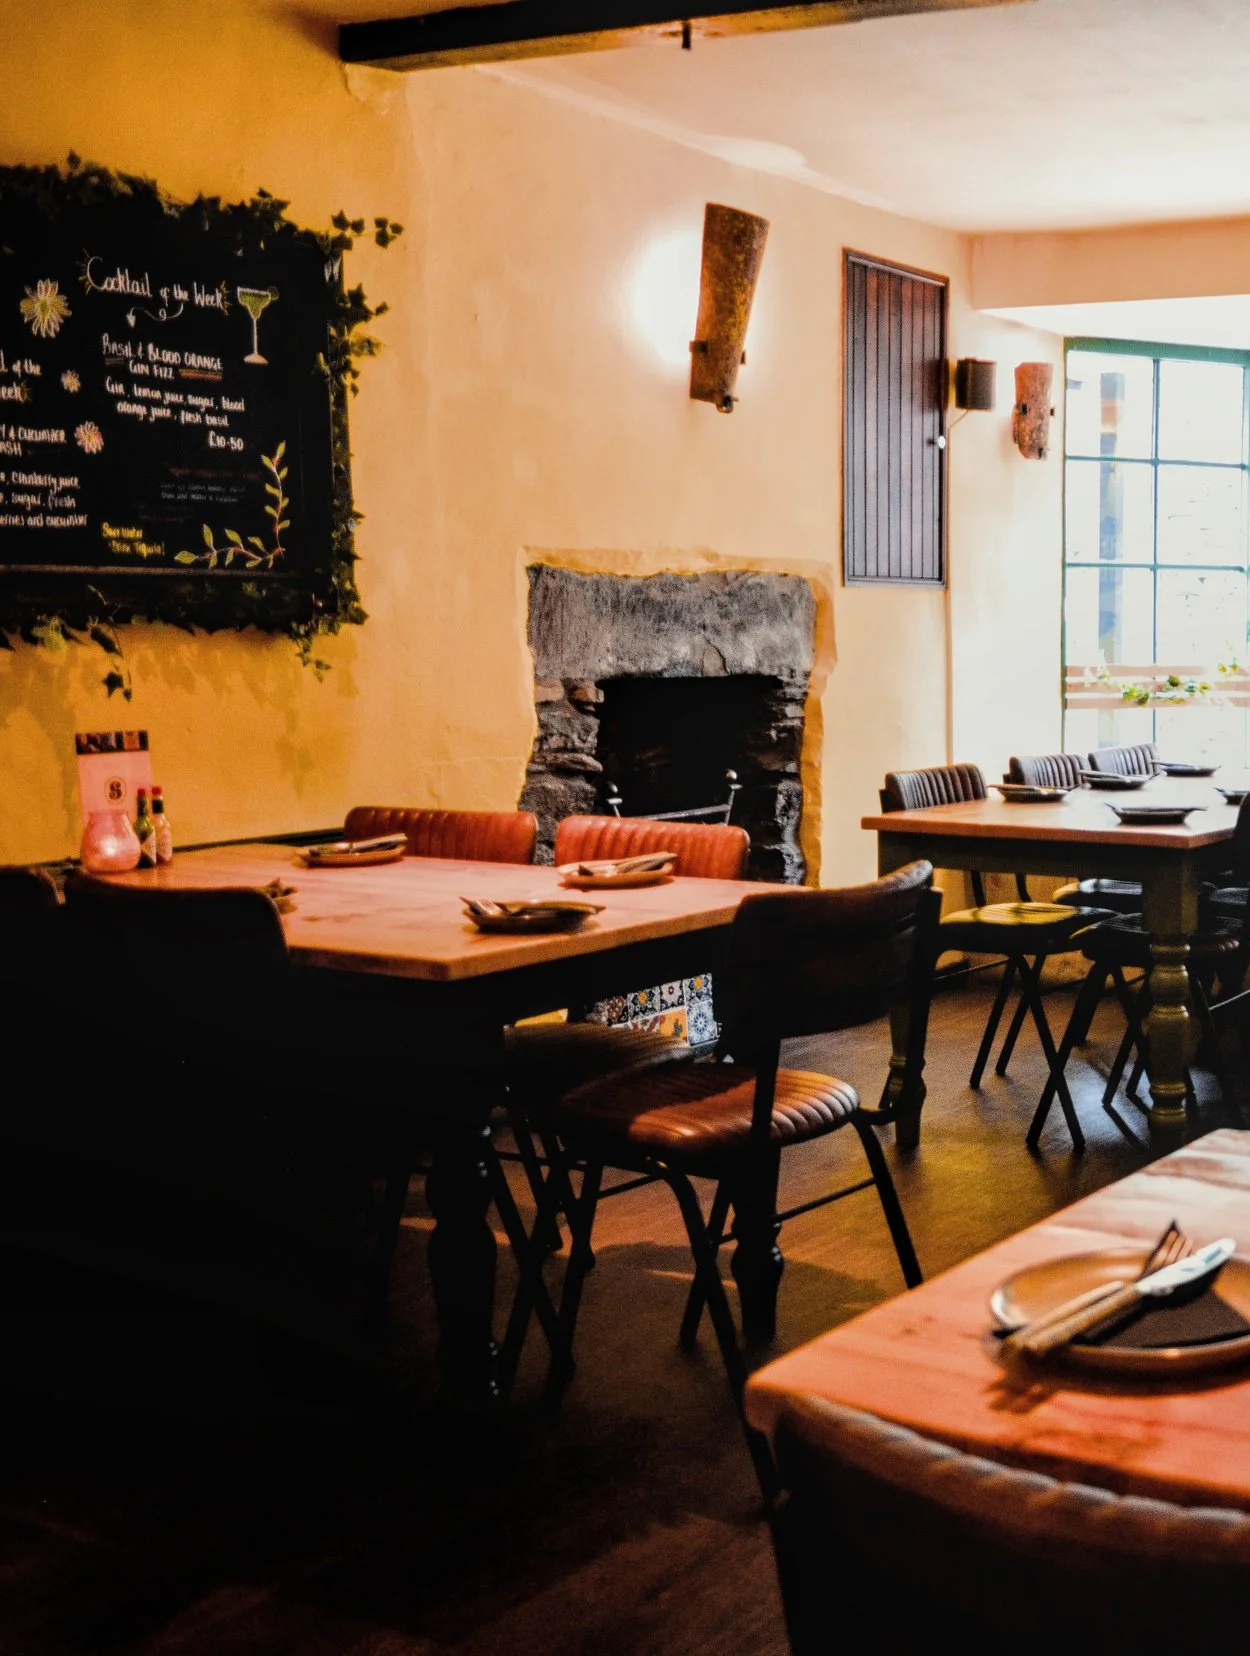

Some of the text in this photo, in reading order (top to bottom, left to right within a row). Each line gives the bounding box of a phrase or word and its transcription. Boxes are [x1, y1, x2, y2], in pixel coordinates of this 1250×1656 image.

[87, 256, 224, 309] Cocktail of the Week
[184, 351, 223, 371] ORANGE
[153, 364, 175, 380] FIZZ
[0, 381, 24, 402] eek
